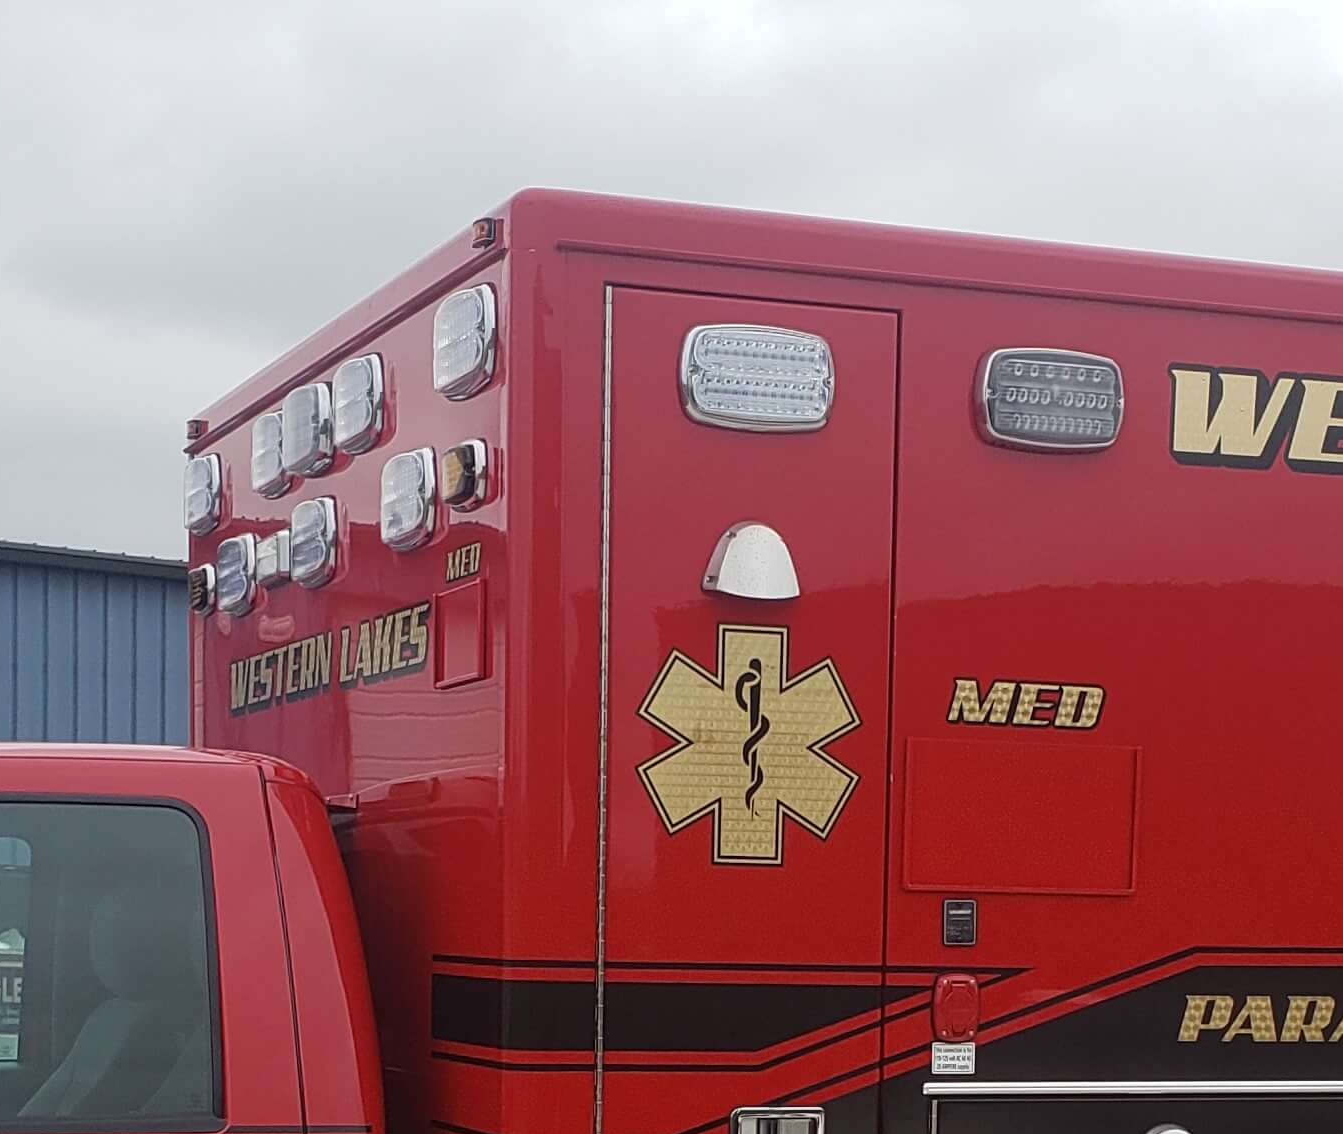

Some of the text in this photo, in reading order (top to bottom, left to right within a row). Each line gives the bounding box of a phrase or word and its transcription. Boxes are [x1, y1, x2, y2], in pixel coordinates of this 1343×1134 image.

[446, 543, 481, 581] MED
[230, 602, 432, 713] WESTERN LAKES
[946, 677, 1105, 729] MED
